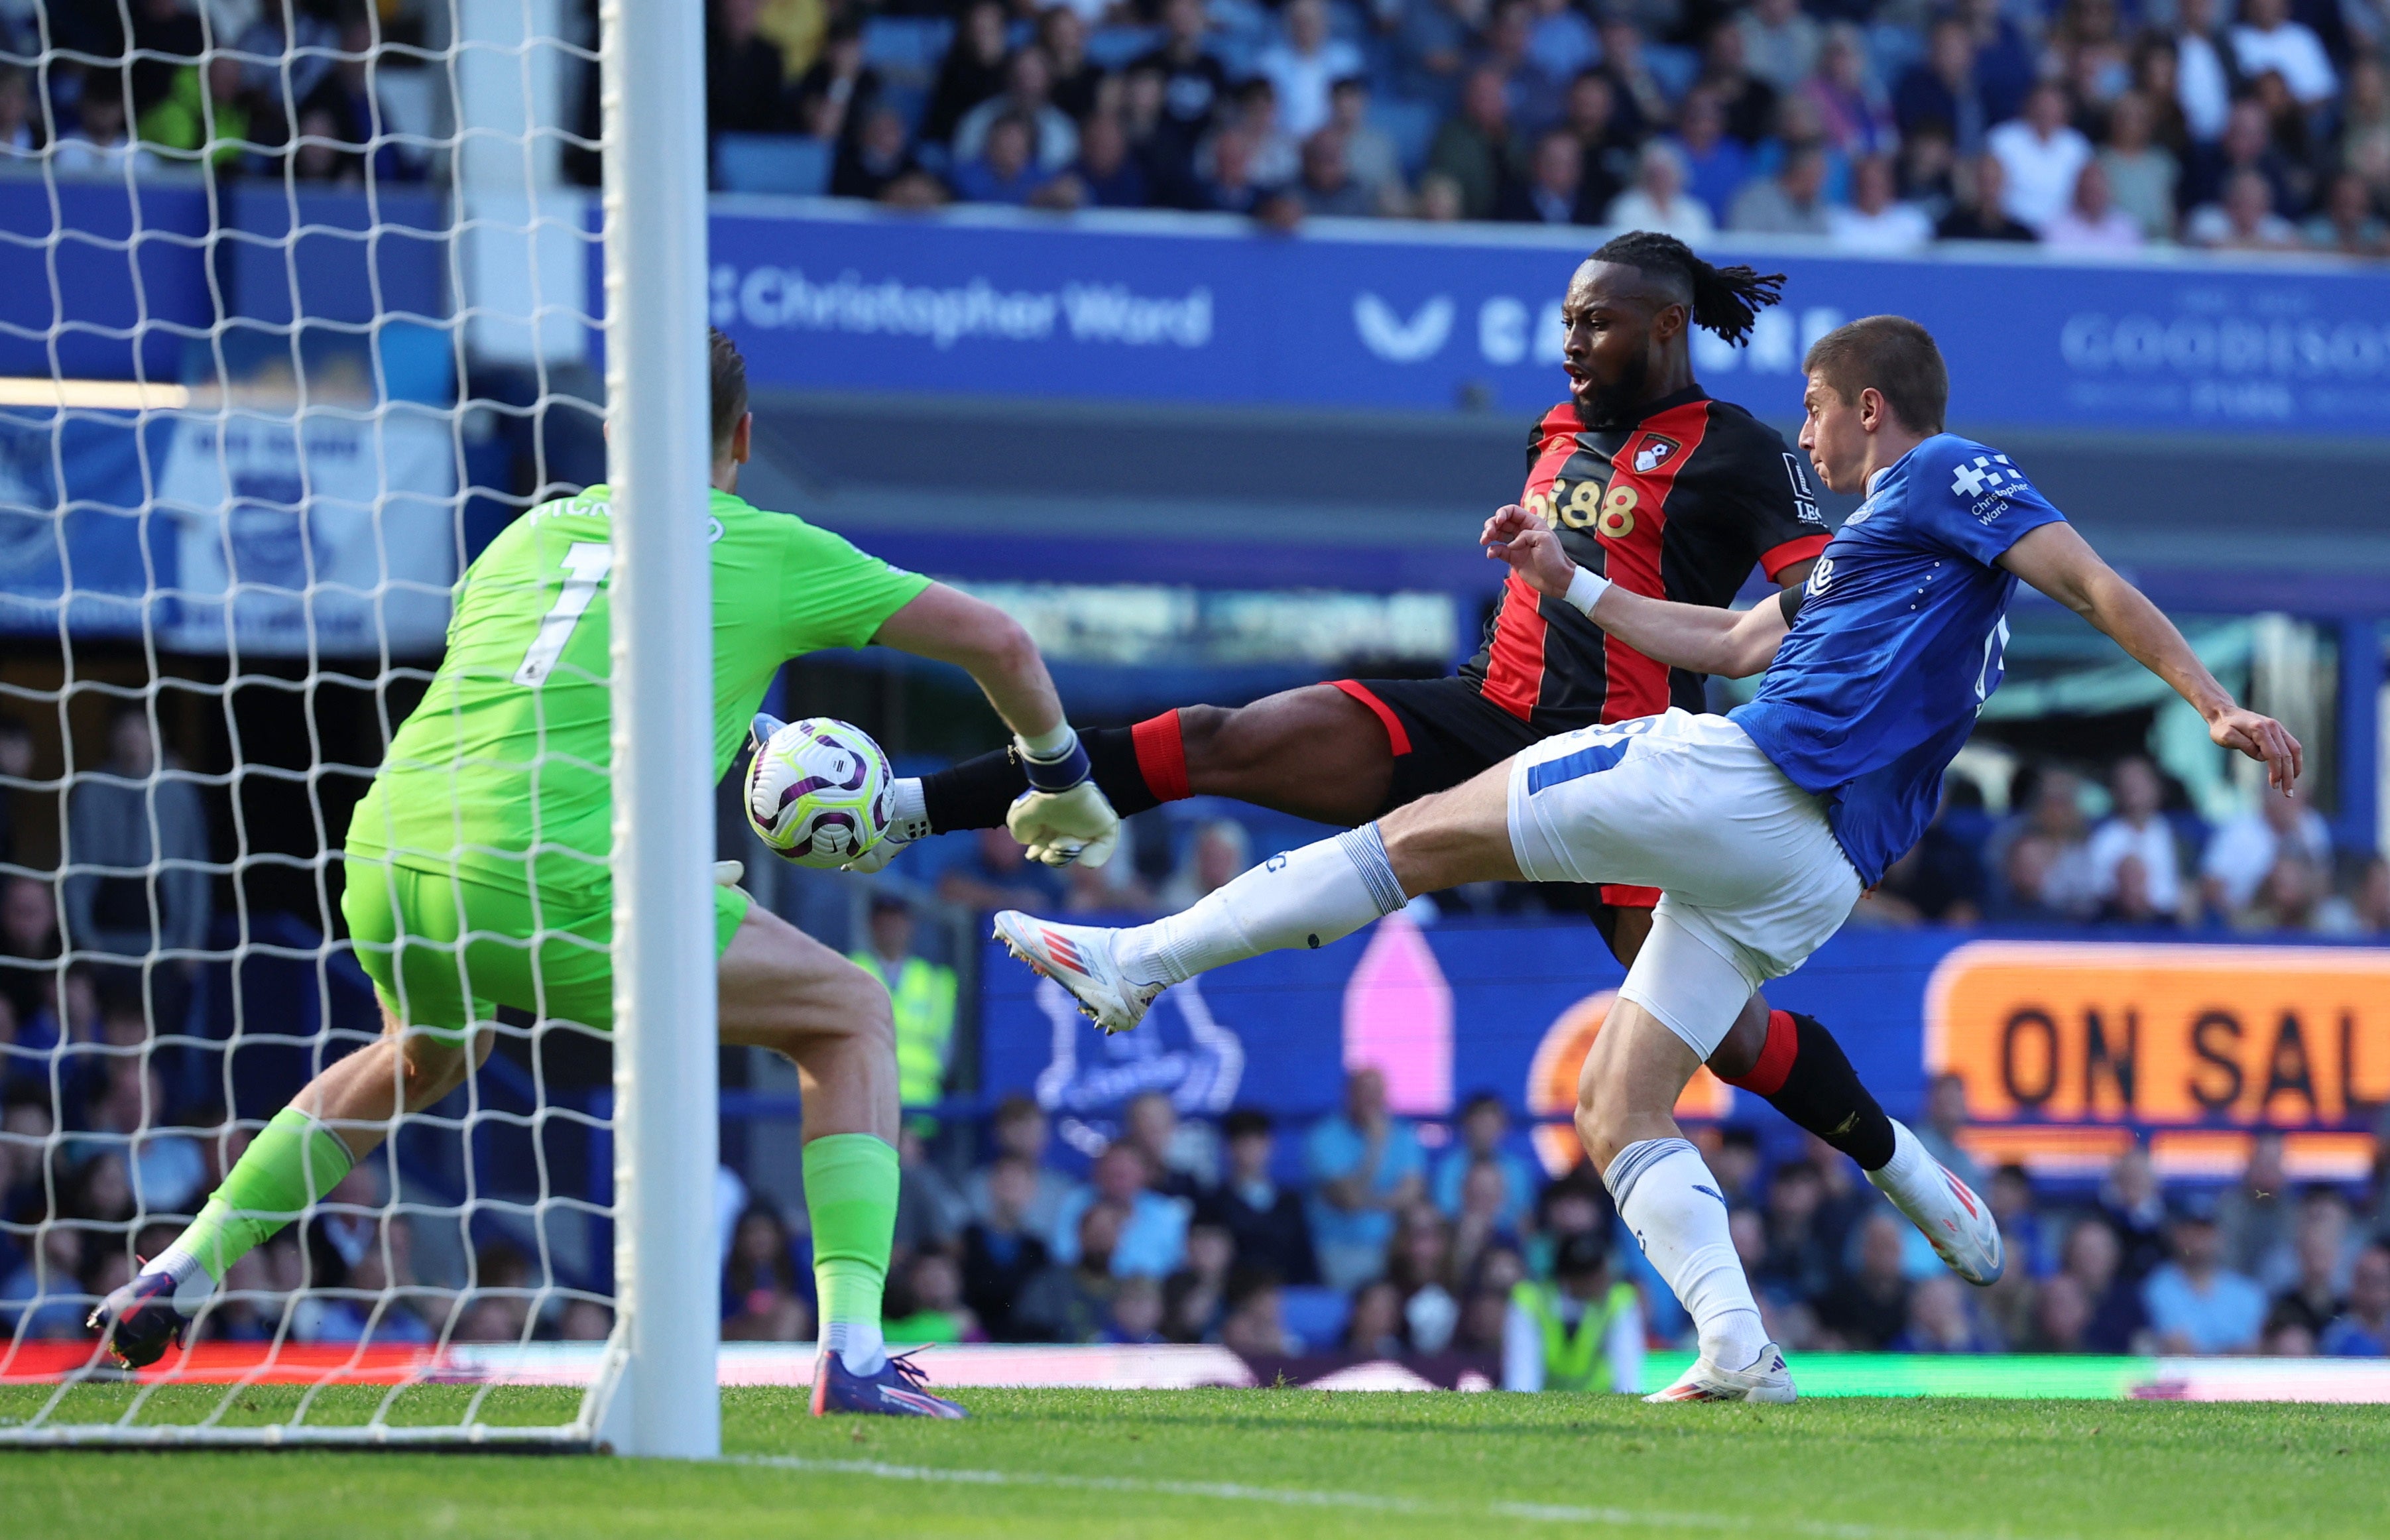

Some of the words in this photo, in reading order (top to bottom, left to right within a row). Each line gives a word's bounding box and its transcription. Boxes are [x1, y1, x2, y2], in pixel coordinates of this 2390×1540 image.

[741, 267, 1055, 349] Christopher
[1061, 281, 1212, 346] Ward
[2060, 313, 2390, 379] GOODISO
[1972, 483, 2029, 515] Christopher
[1979, 501, 2009, 526] Ward
[512, 542, 613, 687] 1
[2002, 1008, 2137, 1106] ON
[2189, 1009, 2388, 1110] SAL
